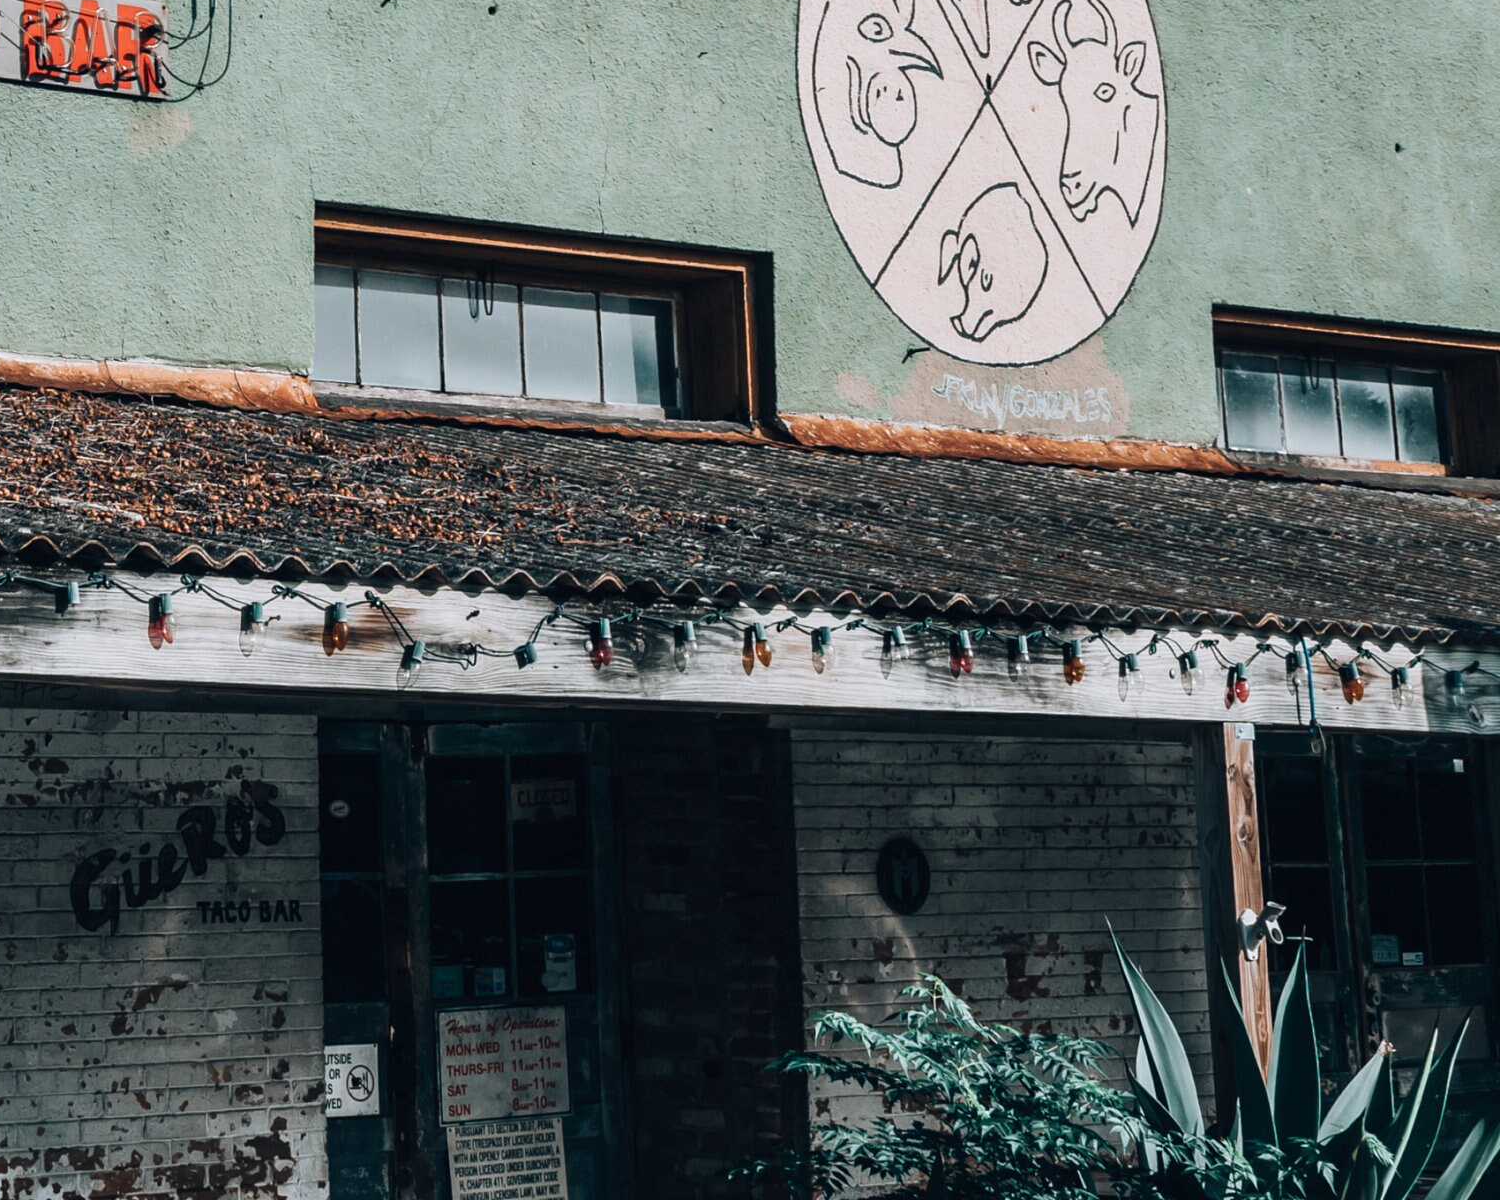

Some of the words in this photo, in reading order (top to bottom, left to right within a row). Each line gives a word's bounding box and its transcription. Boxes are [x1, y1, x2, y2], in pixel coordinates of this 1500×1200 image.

[517, 788, 570, 808] CLOSED
[197, 900, 250, 924] TACO
[259, 899, 303, 923] BAR
[445, 1018, 482, 1035] Hours
[486, 1018, 498, 1036] of
[446, 1041, 501, 1057] MON-WED
[329, 1068, 341, 1080] OR
[446, 1061, 505, 1077] THURS-FRI
[447, 1084, 468, 1097] SAT
[448, 1103, 472, 1117] SUN
[455, 1124, 486, 1137] PURSUANT
[487, 1124, 495, 1135] TO
[496, 1122, 519, 1134] SECTION
[537, 1119, 554, 1131] PENAL
[456, 1140, 471, 1151] CODE
[472, 1137, 502, 1152] (TRESPASS
[503, 1136, 511, 1147] BY
[512, 1134, 534, 1146] LICENSE
[535, 1132, 556, 1143] HOLDER
[453, 1153, 469, 1164] WITH
[470, 1152, 478, 1163] AN
[478, 1151, 501, 1162] OPENLY
[501, 1148, 524, 1160] CARRIED
[555, 1145, 560, 1155] A
[455, 1166, 478, 1178] PERSON
[479, 1163, 505, 1176] LICENSED
[506, 1161, 524, 1172] UNDER
[525, 1158, 561, 1170] SUBCHAPTER
[466, 1178, 492, 1190] CHAPTER
[506, 1173, 543, 1186] GOVERNMENT
[543, 1171, 558, 1182] CODE
[491, 1188, 518, 1200] LICENSING
[536, 1185, 548, 1197] MAY
[548, 1184, 560, 1195] NOT
